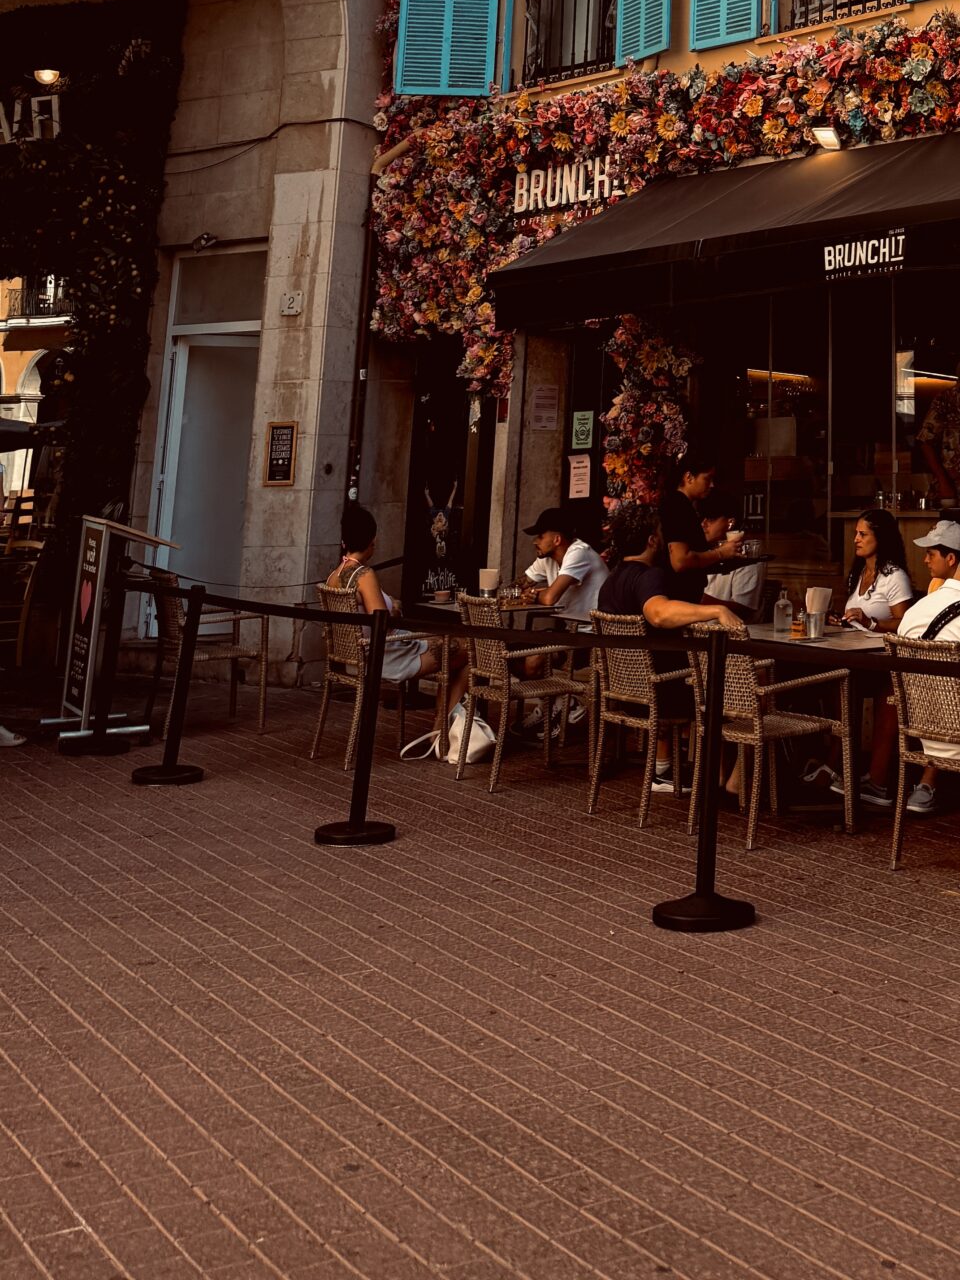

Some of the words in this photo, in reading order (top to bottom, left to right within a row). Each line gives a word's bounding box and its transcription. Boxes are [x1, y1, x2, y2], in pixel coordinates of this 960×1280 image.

[514, 153, 627, 213] BRUNCH
[823, 235, 906, 271] BRUNCHIT
[287, 296, 295, 309] 2
